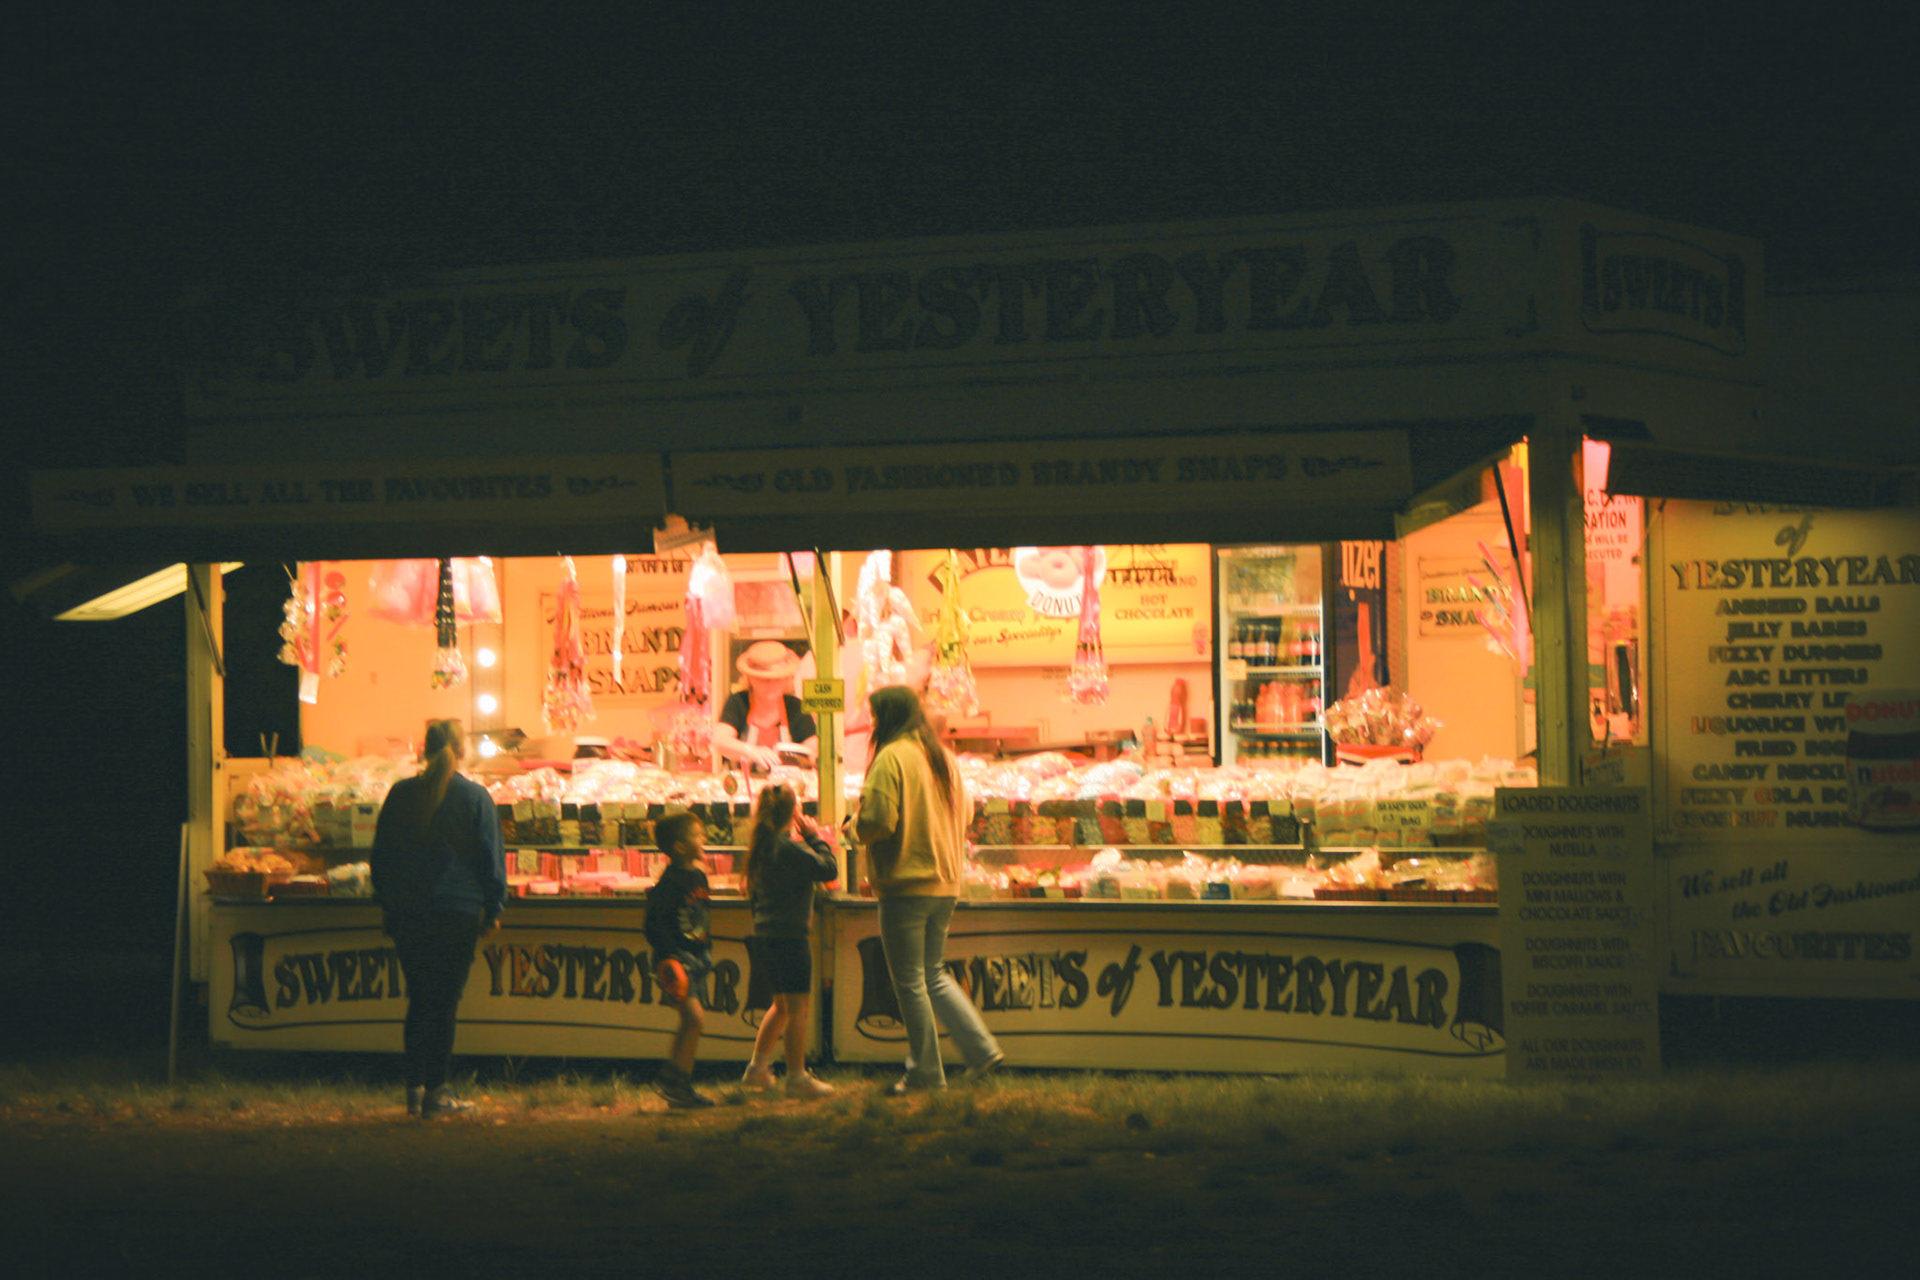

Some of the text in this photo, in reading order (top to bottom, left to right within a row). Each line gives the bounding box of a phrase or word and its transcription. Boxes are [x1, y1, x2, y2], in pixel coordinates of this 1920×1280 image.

[257, 286, 629, 382] SWEETS
[788, 236, 1463, 356] YESTERYEAR
[773, 453, 1288, 495] OLD FASHIONED BRANDY SNAPS
[131, 474, 552, 508] WE SELL ALL THE FAVOURITES
[1670, 554, 1920, 591] YESTERYEAR
[1114, 607, 1194, 620] CHOCOLATE
[1716, 595, 1881, 616] ANISEED BALLS
[1727, 620, 1782, 644] JELLY
[1726, 667, 1868, 687] ABC LETTERS
[1727, 692, 1813, 709] CHERRY
[1692, 716, 1805, 735] LIQUORICE
[1735, 740, 1797, 757] FRIED
[1502, 794, 1640, 812] LOADED DOUGHNUTS
[1549, 842, 1597, 857] NUTELLA
[1522, 871, 1595, 886] DOUGHNUTS
[1760, 859, 1789, 884] all
[1519, 906, 1592, 921] CHOCOLATE
[1525, 937, 1599, 953] DOUGHNUTS
[1691, 930, 1912, 963] FAVOURITES
[276, 946, 401, 1009] SWEET
[1097, 944, 1142, 1017] of
[1149, 949, 1449, 1030] YESTERYEAR
